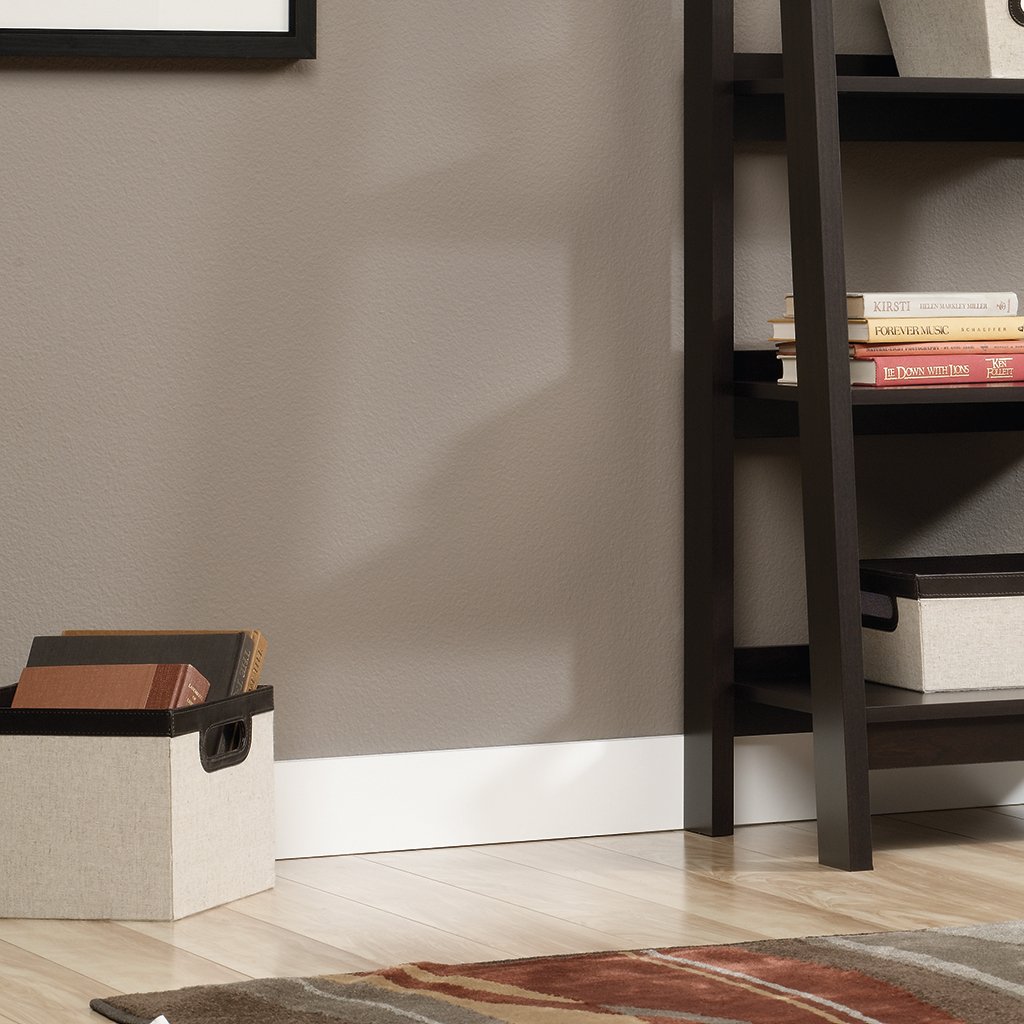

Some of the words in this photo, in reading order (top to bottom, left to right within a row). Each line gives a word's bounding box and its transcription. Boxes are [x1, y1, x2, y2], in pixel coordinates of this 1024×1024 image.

[873, 300, 911, 312] KIRSTI
[875, 325, 920, 336] FOREVER
[920, 325, 950, 336] MUSIC
[991, 358, 1007, 369] KEN
[896, 366, 925, 380] DOWN
[926, 366, 948, 376] WITH
[948, 364, 970, 377] LIONS
[986, 367, 1014, 379] FOLLETT
